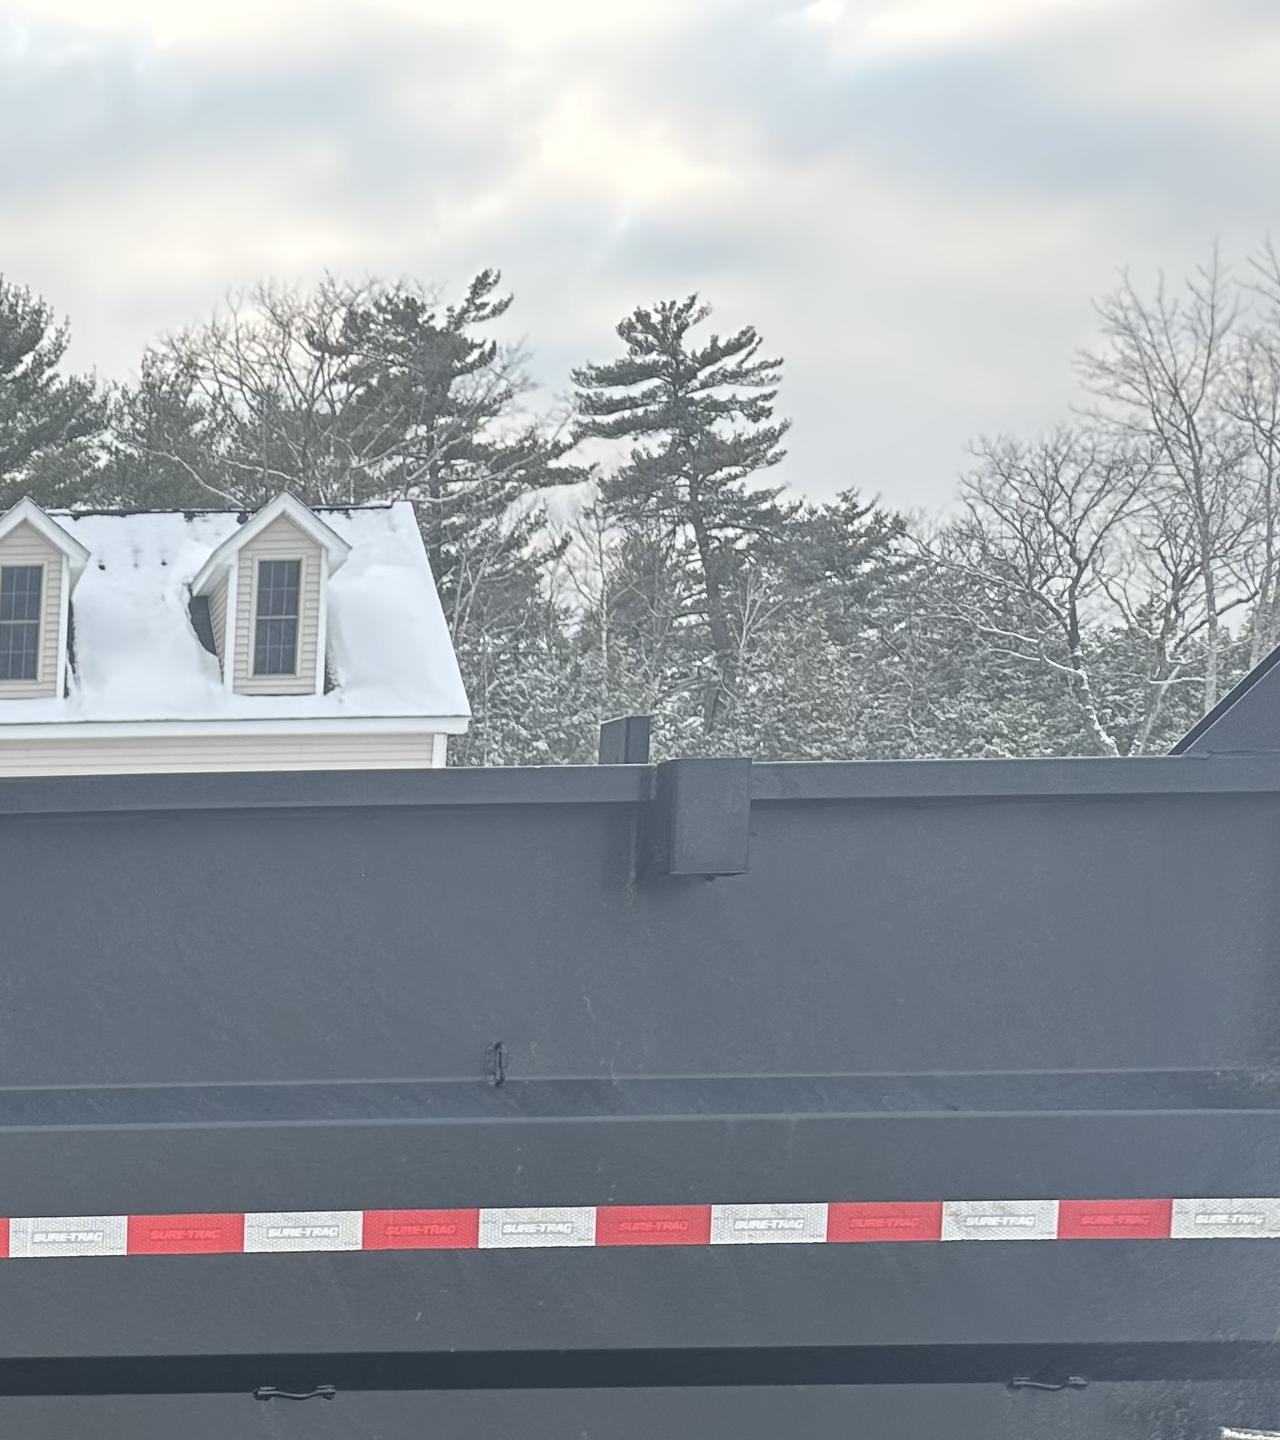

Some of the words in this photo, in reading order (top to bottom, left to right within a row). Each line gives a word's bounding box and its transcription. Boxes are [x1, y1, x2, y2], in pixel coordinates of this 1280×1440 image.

[735, 1220, 804, 1230] SURE-TRAC
[966, 1216, 1035, 1227] SURE-TRAC
[269, 1227, 338, 1238] SURE-TRAC
[503, 1222, 573, 1233] SURE-TRAC
[34, 1232, 103, 1243] SURE-TRAC
